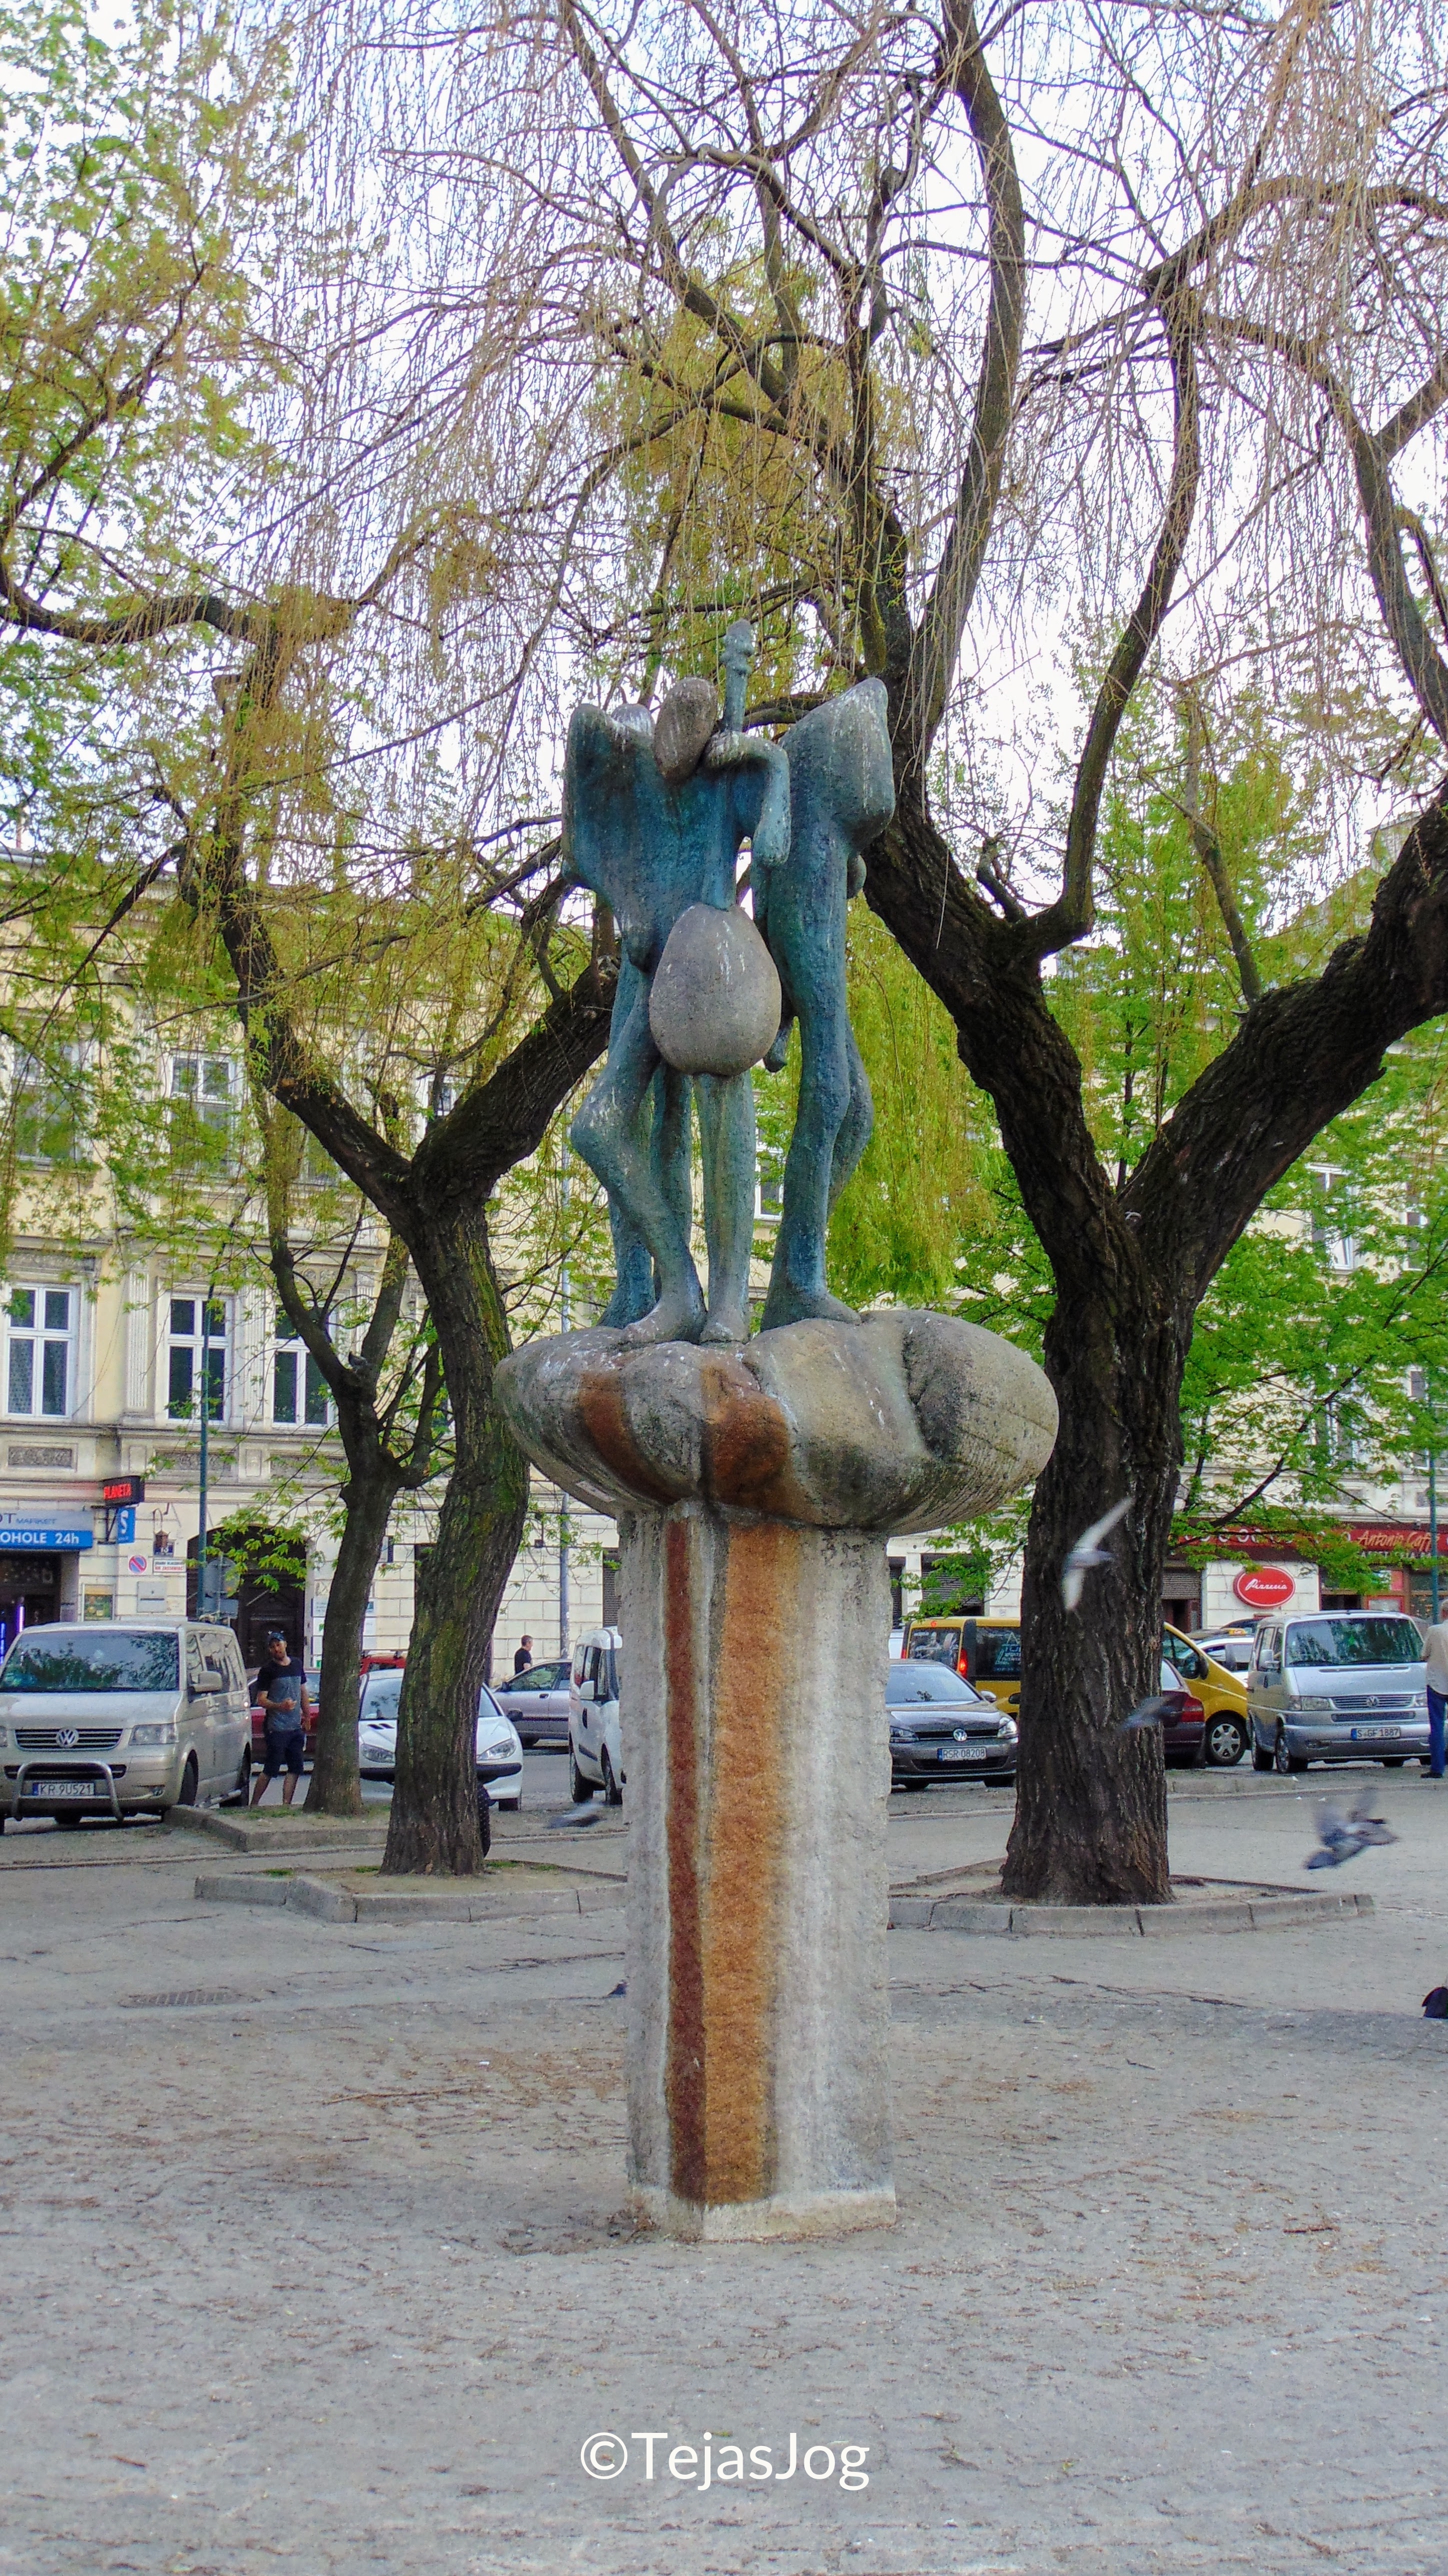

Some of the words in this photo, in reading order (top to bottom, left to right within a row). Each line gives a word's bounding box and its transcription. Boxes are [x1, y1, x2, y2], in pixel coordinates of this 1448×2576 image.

[103, 1483, 131, 1500] PLANETA
[0, 1531, 48, 1544] OHOLE
[55, 1532, 79, 1544] 24h
[1358, 1530, 1404, 1548] Antonio
[1407, 1531, 1441, 1553] Caff
[1245, 1578, 1287, 1591] Pizzeria
